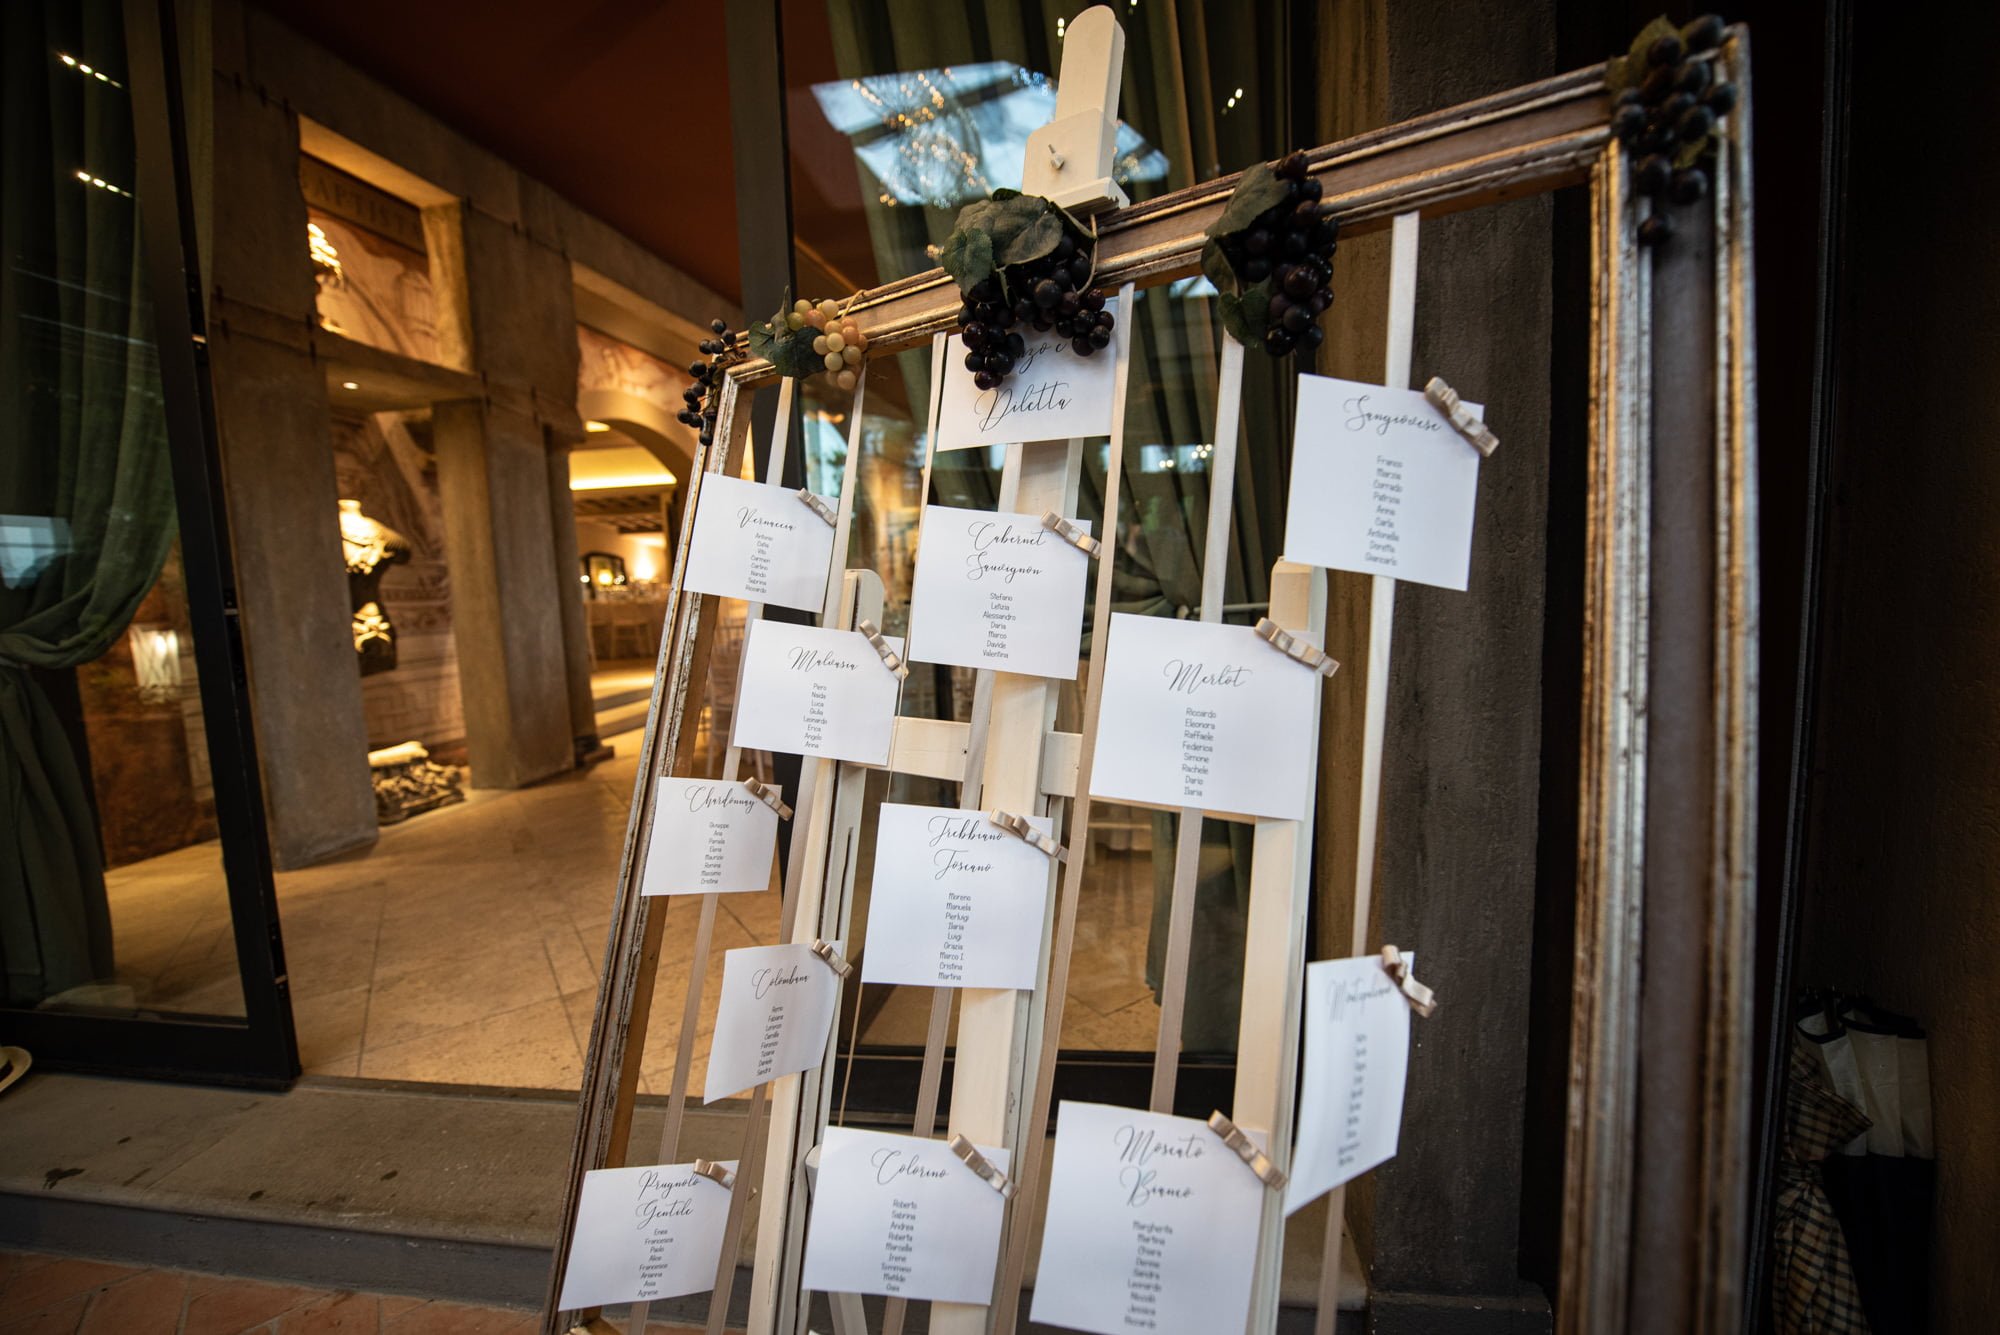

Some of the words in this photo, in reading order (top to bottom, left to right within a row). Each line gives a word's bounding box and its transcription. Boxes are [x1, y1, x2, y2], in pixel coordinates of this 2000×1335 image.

[974, 381, 1073, 432] Diletta
[1343, 395, 1442, 435] Sangiovese
[1377, 455, 1403, 468] Franco
[1373, 480, 1403, 493] Corrado
[1376, 505, 1396, 516] Anna
[737, 506, 796, 531] Vernaccia
[968, 521, 1054, 551] Cabernet
[751, 555, 770, 563] Carmen
[967, 552, 1042, 584] Sauvignon
[748, 577, 767, 586] Sabrina
[990, 593, 1013, 602] Stefano
[991, 603, 1010, 611] Letizia
[983, 612, 1016, 621] Alessandro
[991, 622, 1006, 630] Daria
[988, 631, 1007, 639] Marco
[987, 640, 1006, 649] Davide
[788, 646, 859, 672] Malvasia
[983, 650, 1009, 659] Valentina
[1163, 659, 1254, 694] Merlot
[813, 683, 827, 691] Piero
[810, 708, 823, 716] Giulia
[1186, 707, 1217, 719] Riccardo
[803, 716, 827, 725] Leonardo
[1184, 719, 1216, 730] Eleonora
[1184, 730, 1214, 741] Raffaele
[805, 741, 819, 749] Anna
[1182, 741, 1213, 752] Federica
[1184, 753, 1210, 763] Simone
[1182, 764, 1209, 775] Rachele
[1185, 776, 1204, 785] Dario
[1184, 786, 1203, 797] Ilaria
[685, 785, 757, 814] Chardonnay
[928, 816, 1006, 847] Trebbiano
[934, 848, 993, 880] Toscano
[949, 893, 971, 901] Moreno
[946, 903, 971, 911] Manuela
[945, 912, 969, 922] Pierluigi
[948, 923, 964, 931] Ilaria
[947, 933, 962, 941] Luigi
[944, 942, 964, 950] Grazia
[940, 952, 959, 961] Marco
[939, 962, 963, 971] Cristina
[938, 972, 961, 981] Martina
[1114, 1124, 1207, 1165] Moscato
[871, 1148, 948, 1186] Colorino
[638, 1170, 701, 1200] Prugnolo
[1119, 1166, 1194, 1208] Bianco
[635, 1198, 694, 1230] Gentile
[892, 1211, 916, 1221] Sabrina
[890, 1221, 914, 1231] Andrea
